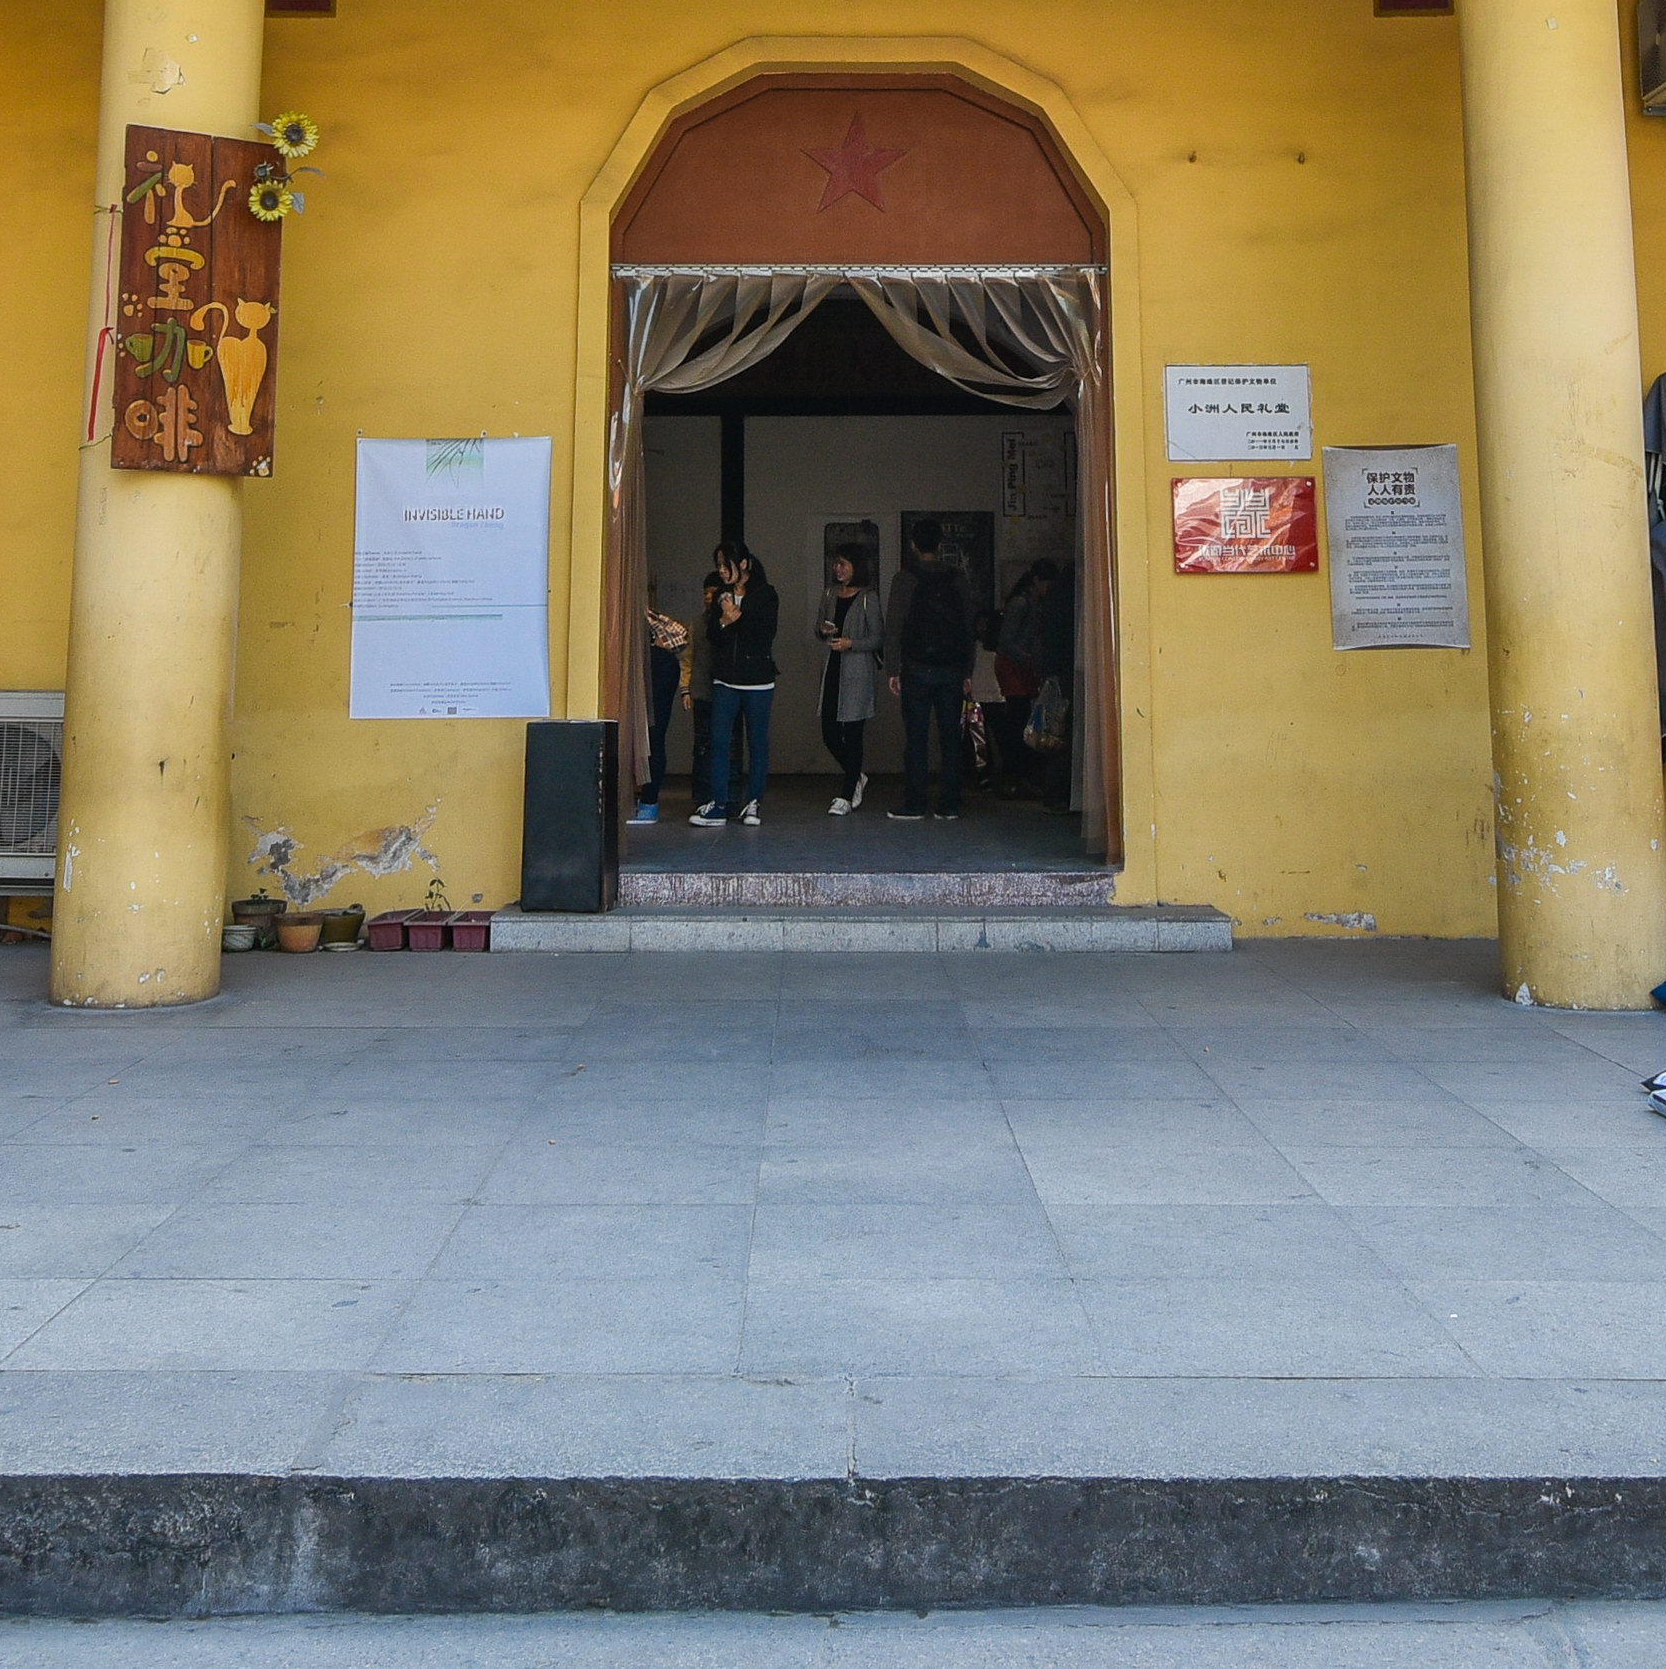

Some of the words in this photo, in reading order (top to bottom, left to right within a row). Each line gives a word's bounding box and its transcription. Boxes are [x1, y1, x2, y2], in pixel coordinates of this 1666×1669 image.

[1187, 403, 1291, 414] 小洲人民礼堂
[1366, 472, 1415, 484] 保护文物
[1367, 484, 1416, 497] 人人有责
[404, 507, 465, 522] INVISIBLE
[466, 506, 505, 521] HAND
